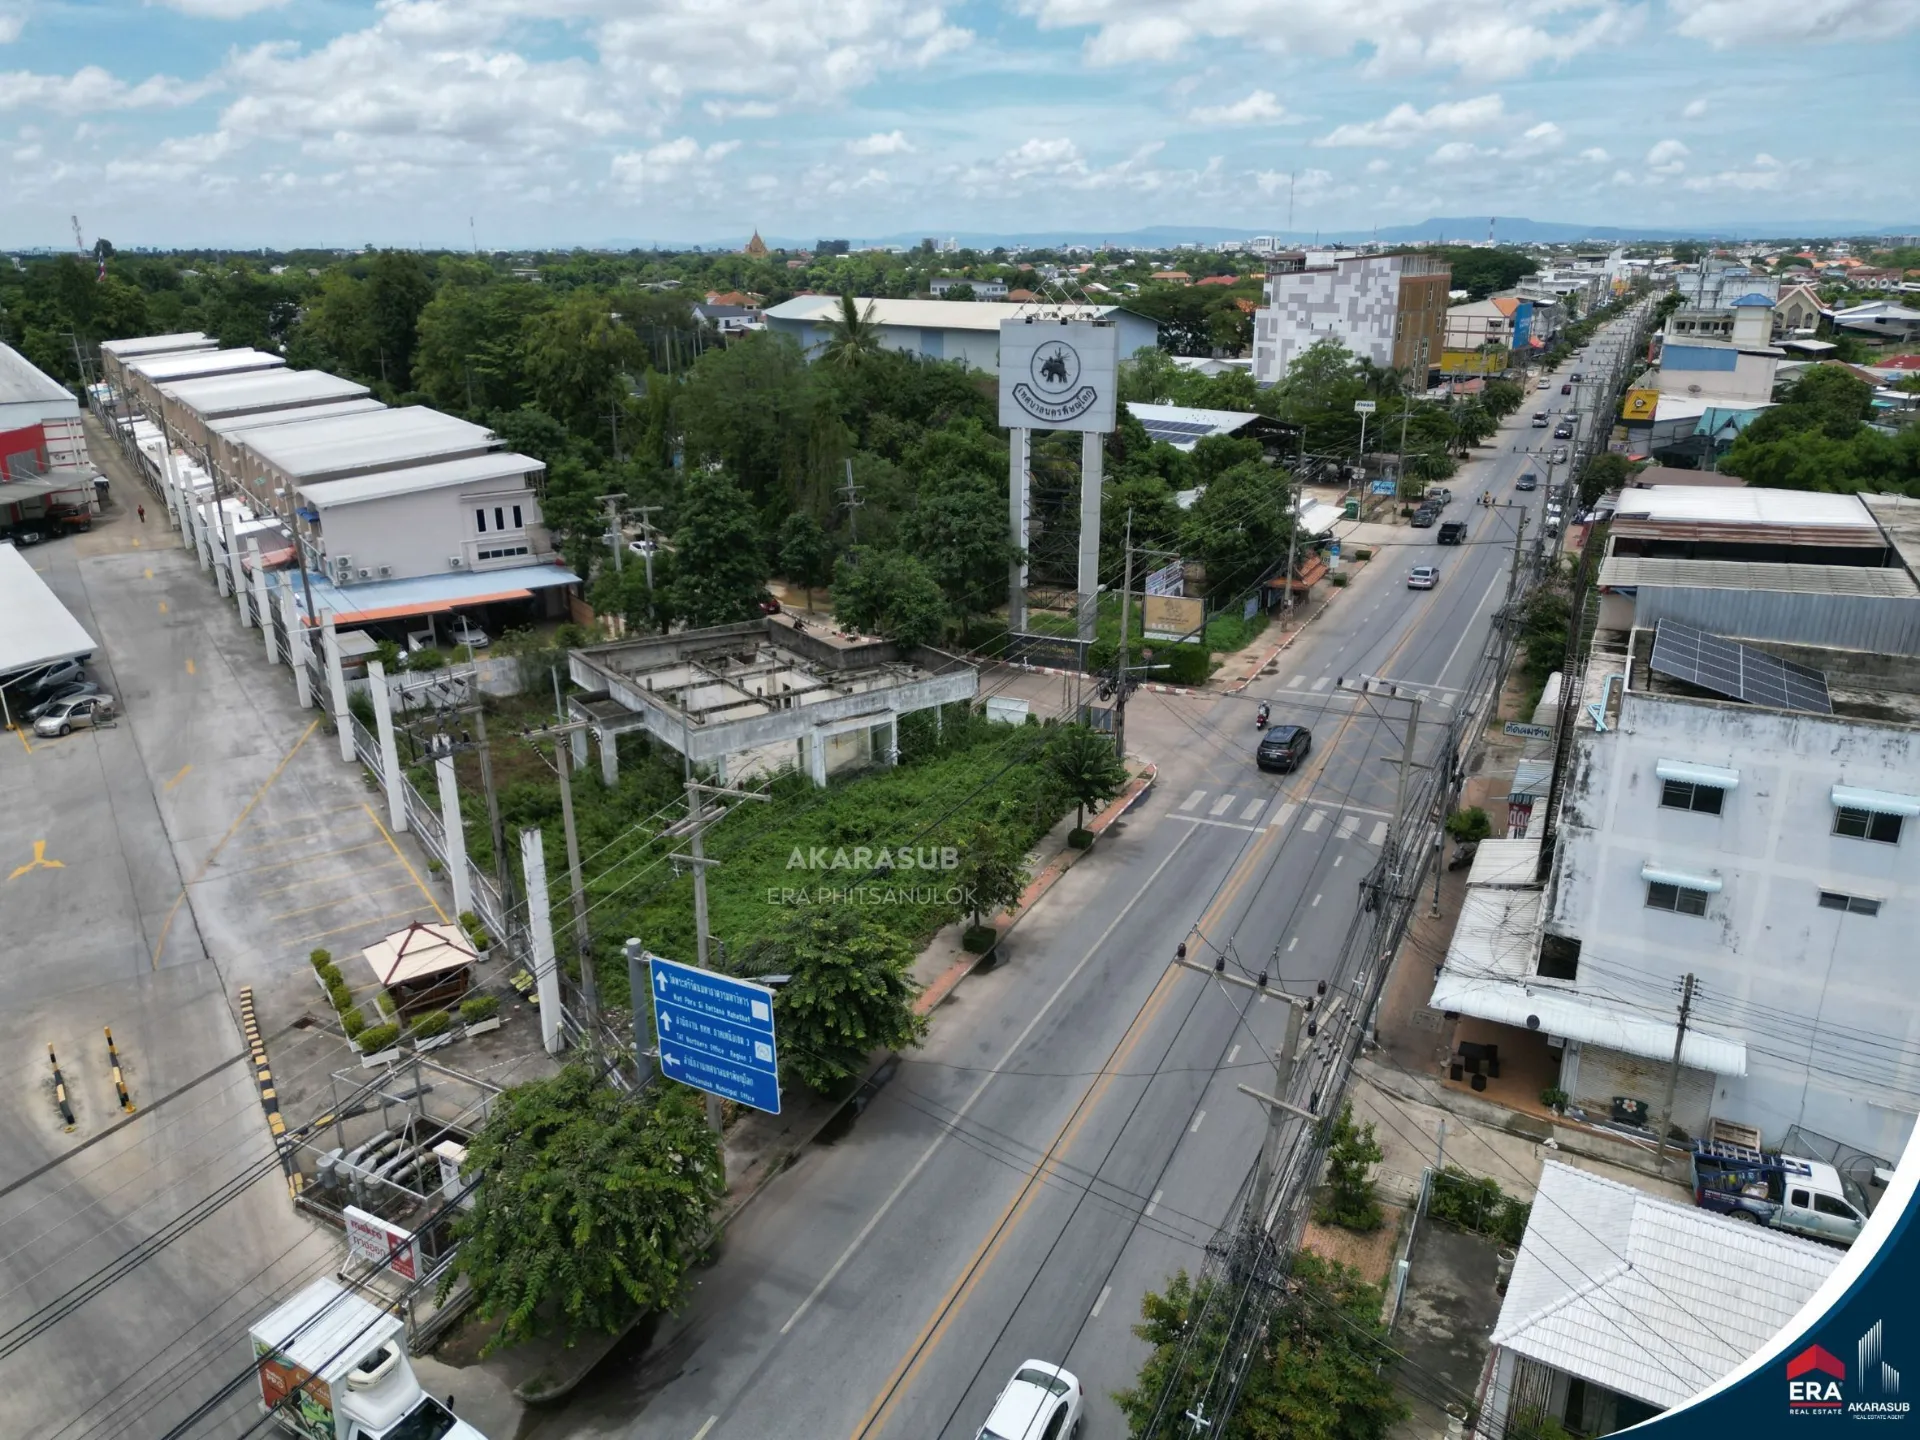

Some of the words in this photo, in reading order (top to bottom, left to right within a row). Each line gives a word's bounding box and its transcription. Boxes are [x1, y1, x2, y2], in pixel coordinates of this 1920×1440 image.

[1017, 387, 1093, 418] เทศบาลนครพิษณุโลก
[350, 1220, 383, 1240] makro
